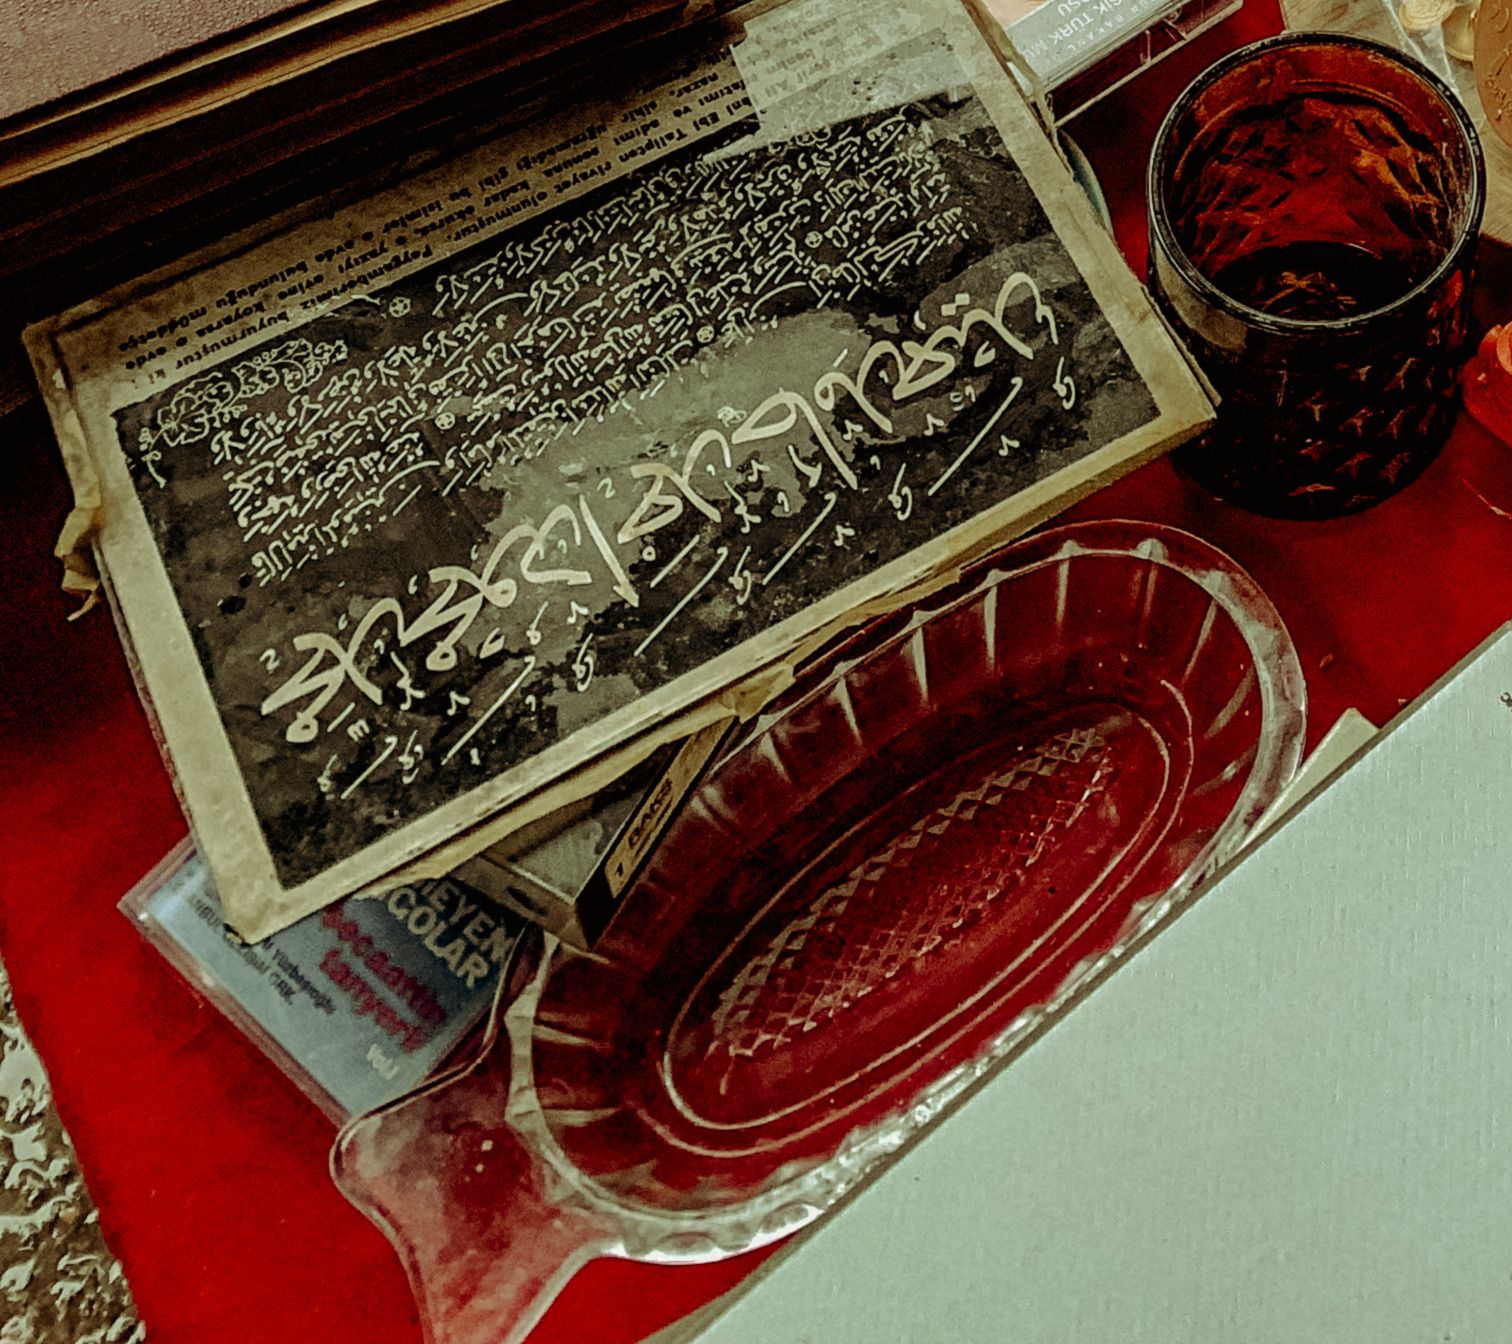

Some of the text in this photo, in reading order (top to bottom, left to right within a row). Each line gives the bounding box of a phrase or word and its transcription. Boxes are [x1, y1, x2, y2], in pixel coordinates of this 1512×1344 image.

[1046, 8, 1094, 46] TÜRK
[691, 109, 720, 132] Ebi
[475, 165, 510, 190] gibi
[480, 177, 530, 209] kadar
[551, 155, 613, 195] rivayet
[380, 198, 442, 235] isimler
[213, 258, 308, 311] bulunduğu
[275, 272, 325, 303] evine
[297, 240, 432, 313] Peygamberimiz
[193, 297, 264, 340] koyarsa
[172, 307, 289, 371] buyurmuştur
[123, 344, 168, 373] evde
